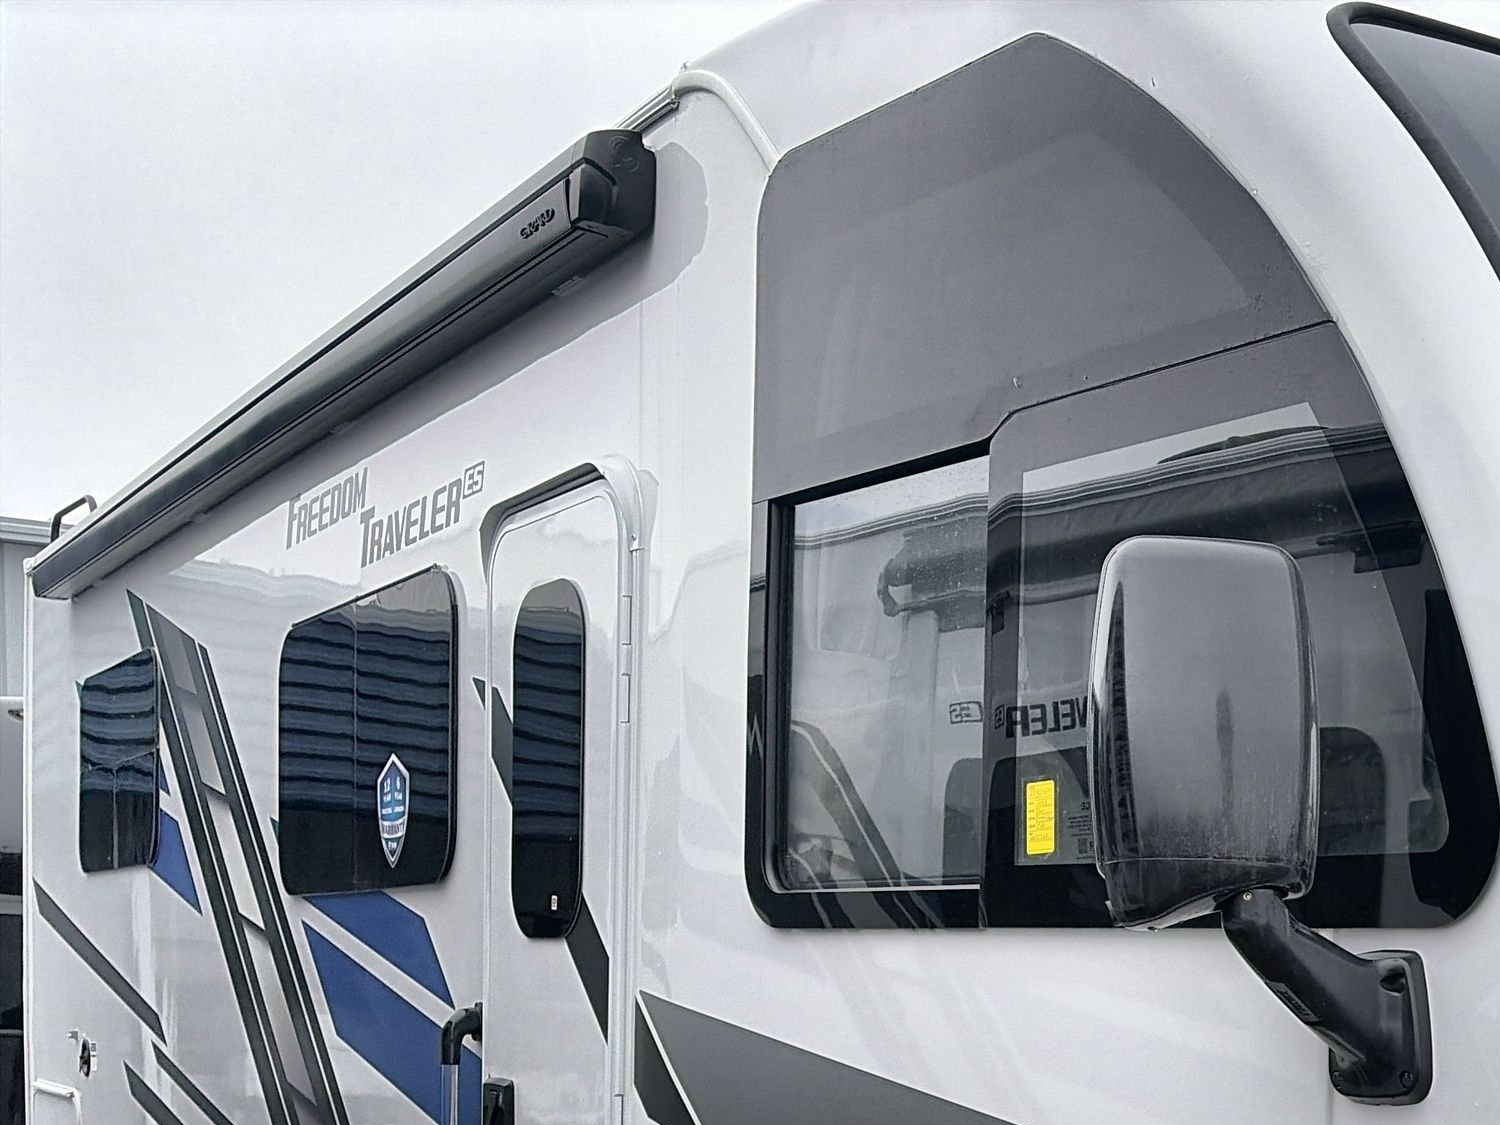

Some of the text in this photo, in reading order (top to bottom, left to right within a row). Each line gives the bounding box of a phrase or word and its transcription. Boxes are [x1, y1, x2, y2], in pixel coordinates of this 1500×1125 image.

[286, 467, 368, 550] FREEDOM
[360, 463, 484, 569] TRAVELER ES
